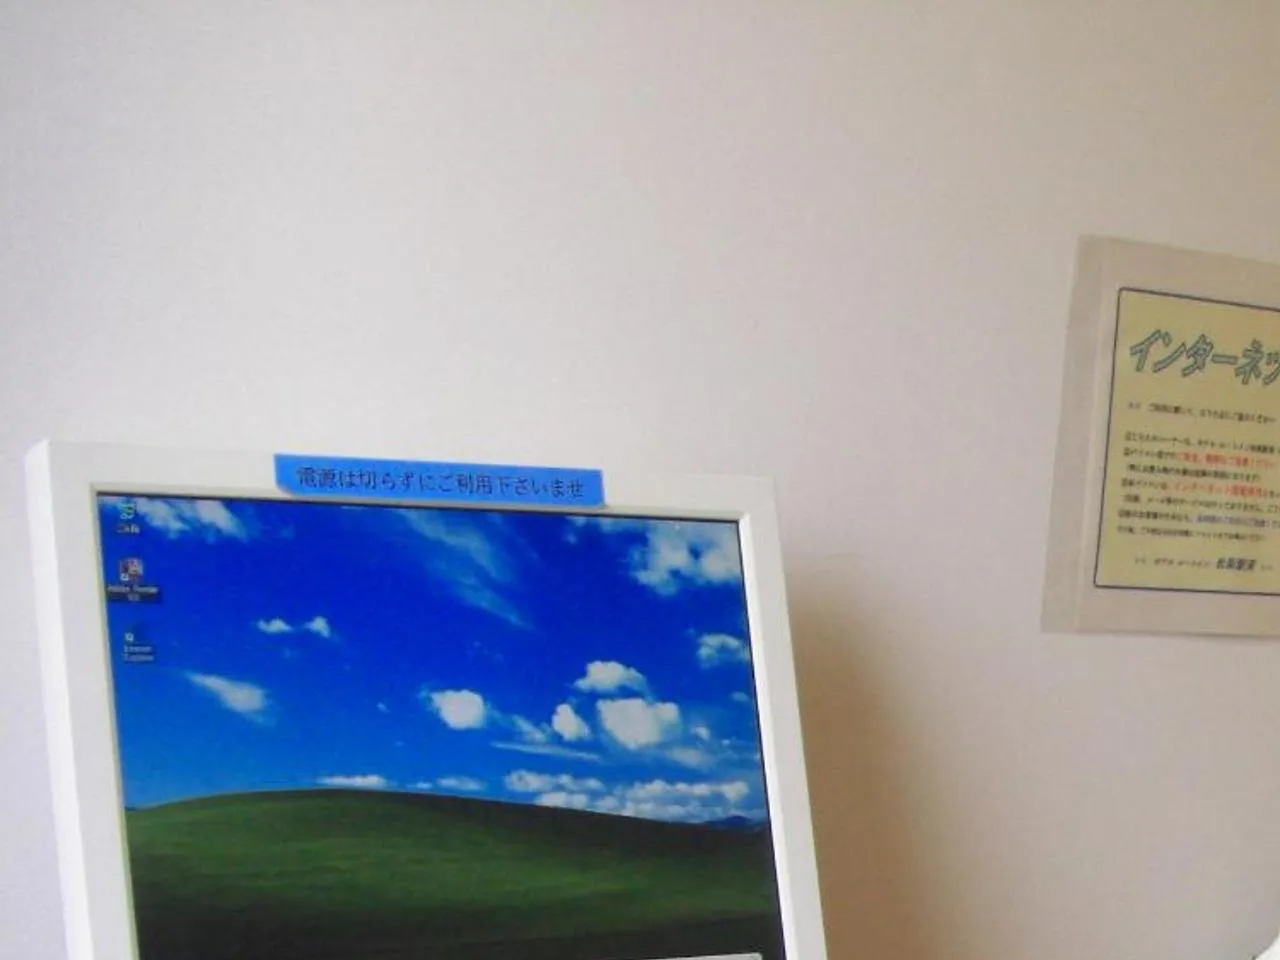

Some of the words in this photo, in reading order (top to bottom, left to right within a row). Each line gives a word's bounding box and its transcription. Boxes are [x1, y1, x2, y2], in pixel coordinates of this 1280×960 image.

[296, 465, 586, 499] 電源は切らずにご利用下さいませ
